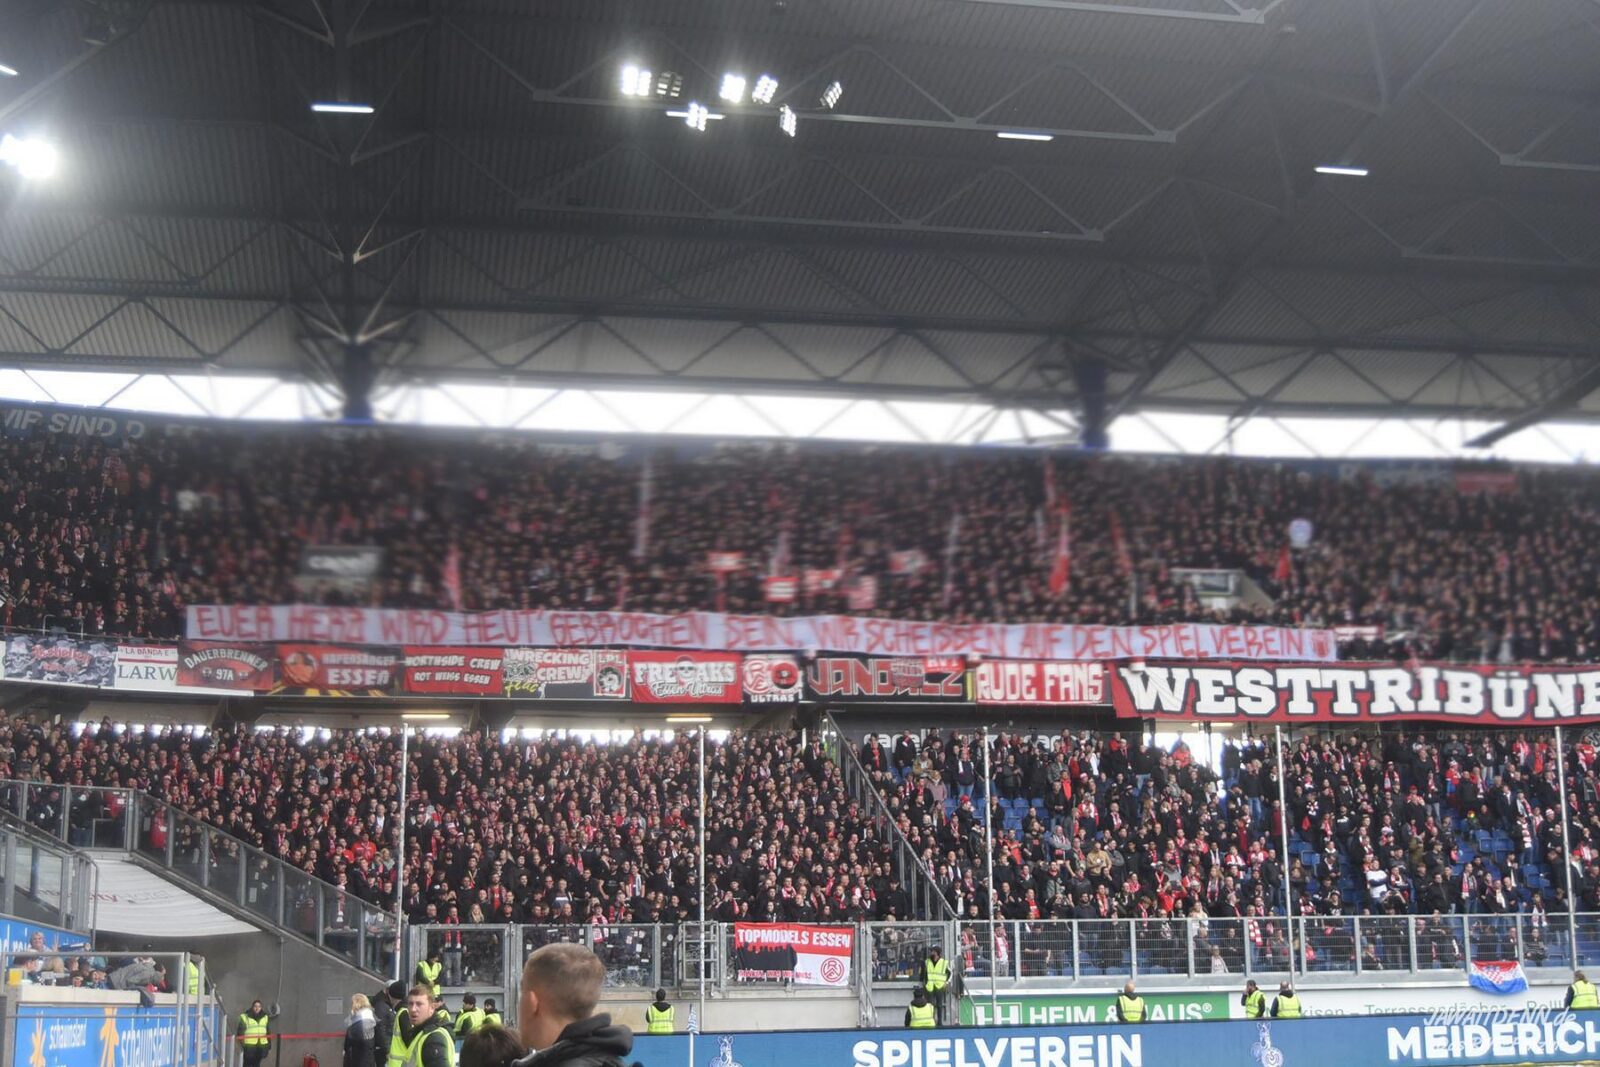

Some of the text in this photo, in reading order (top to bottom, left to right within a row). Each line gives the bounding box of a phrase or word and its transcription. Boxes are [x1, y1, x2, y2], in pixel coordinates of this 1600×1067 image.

[49, 413, 117, 437] SIND
[1072, 625, 1132, 658] DEN
[183, 648, 269, 672] DAUERBRENNER
[404, 654, 501, 671] NORTHSIDE CREW
[508, 650, 591, 665] WRECKING
[215, 669, 234, 681] 97A
[328, 668, 390, 686] ESSEN
[414, 671, 491, 685] ROT WEISS ESSEN
[536, 664, 583, 682] CREW
[976, 662, 1036, 700] RUDE
[1043, 662, 1104, 701] FANS
[750, 693, 795, 703] ULTRAS
[1118, 665, 1600, 719] WESTTRIBÜNE
[737, 928, 851, 948] TOPMODELS ESSEN
[852, 1034, 1142, 1067] SPIELVEREIN
